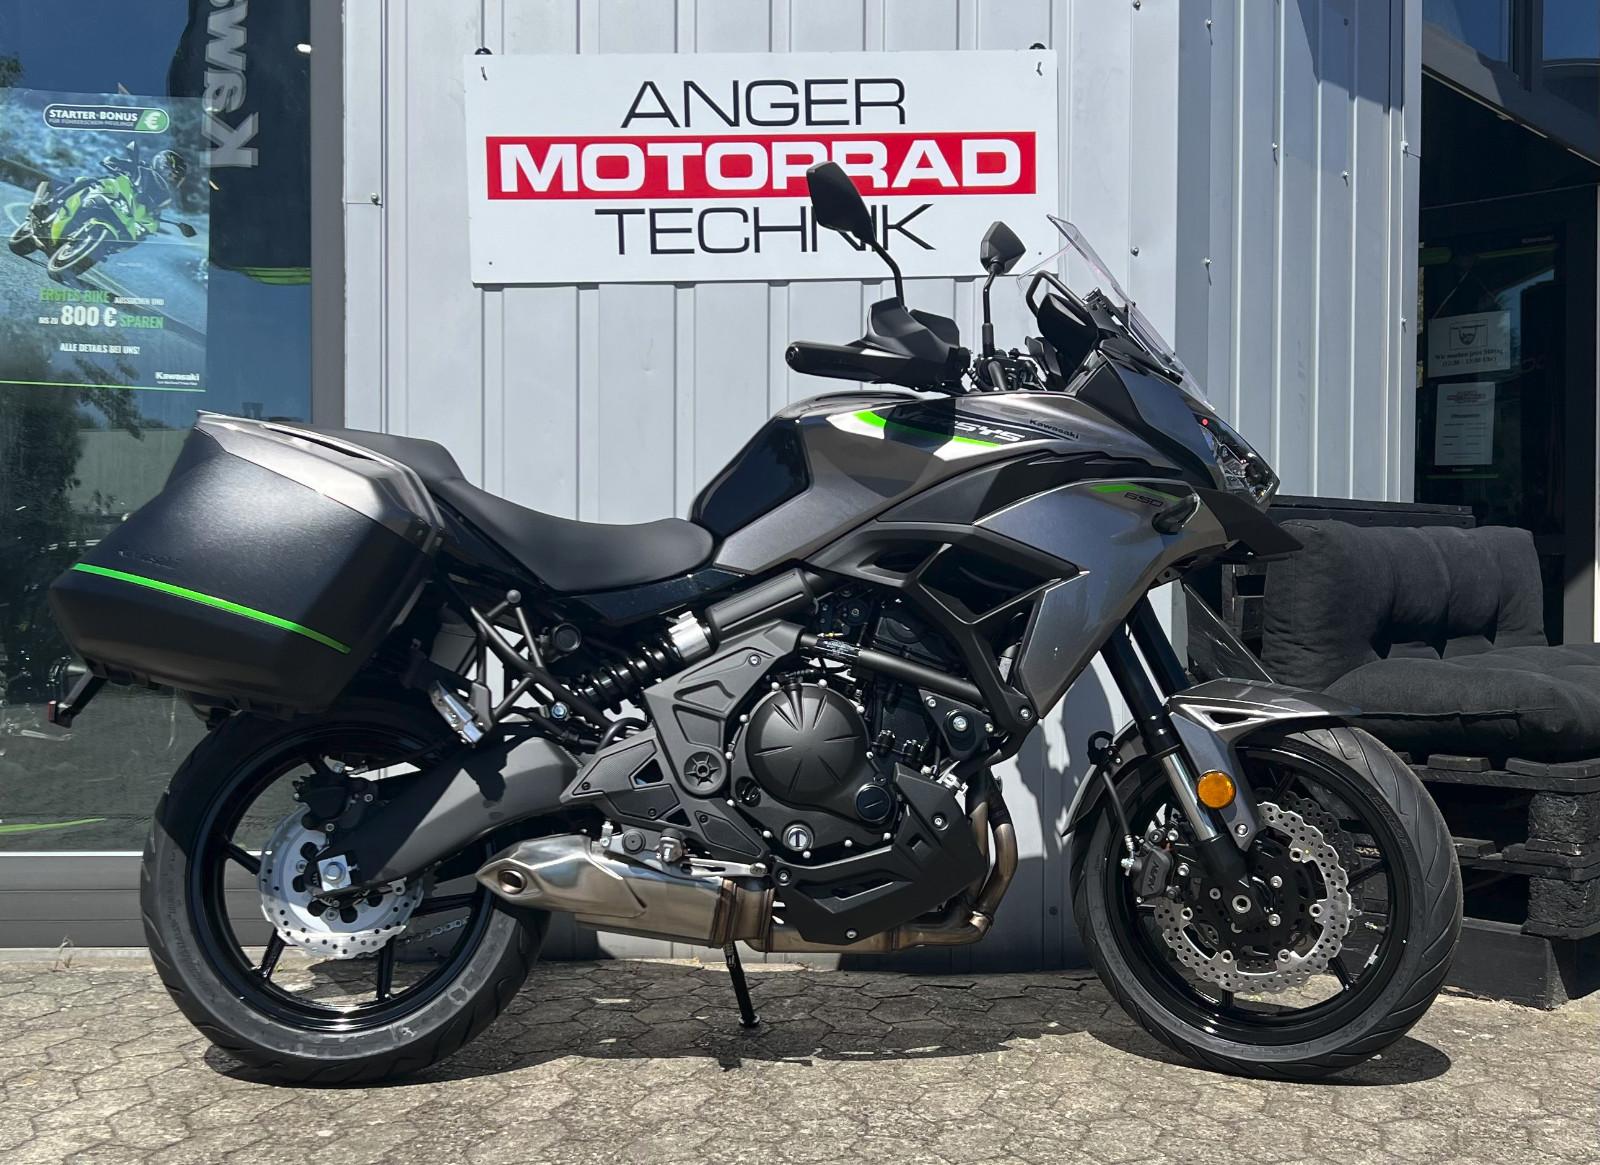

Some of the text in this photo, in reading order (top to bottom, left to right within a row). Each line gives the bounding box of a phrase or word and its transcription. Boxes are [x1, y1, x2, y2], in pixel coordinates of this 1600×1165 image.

[201, 0, 259, 168] Kaw
[621, 78, 906, 129] ANGER
[499, 137, 1022, 193] MOTORRAD
[61, 305, 100, 327] 800
[103, 306, 117, 327] €
[120, 314, 164, 329] SPAREN
[60, 343, 78, 352] ALLE
[78, 343, 108, 353] DETAILS
[155, 371, 200, 381] Kawasaki
[1029, 418, 1080, 440] Kawasaki
[1124, 491, 1164, 508] 650
